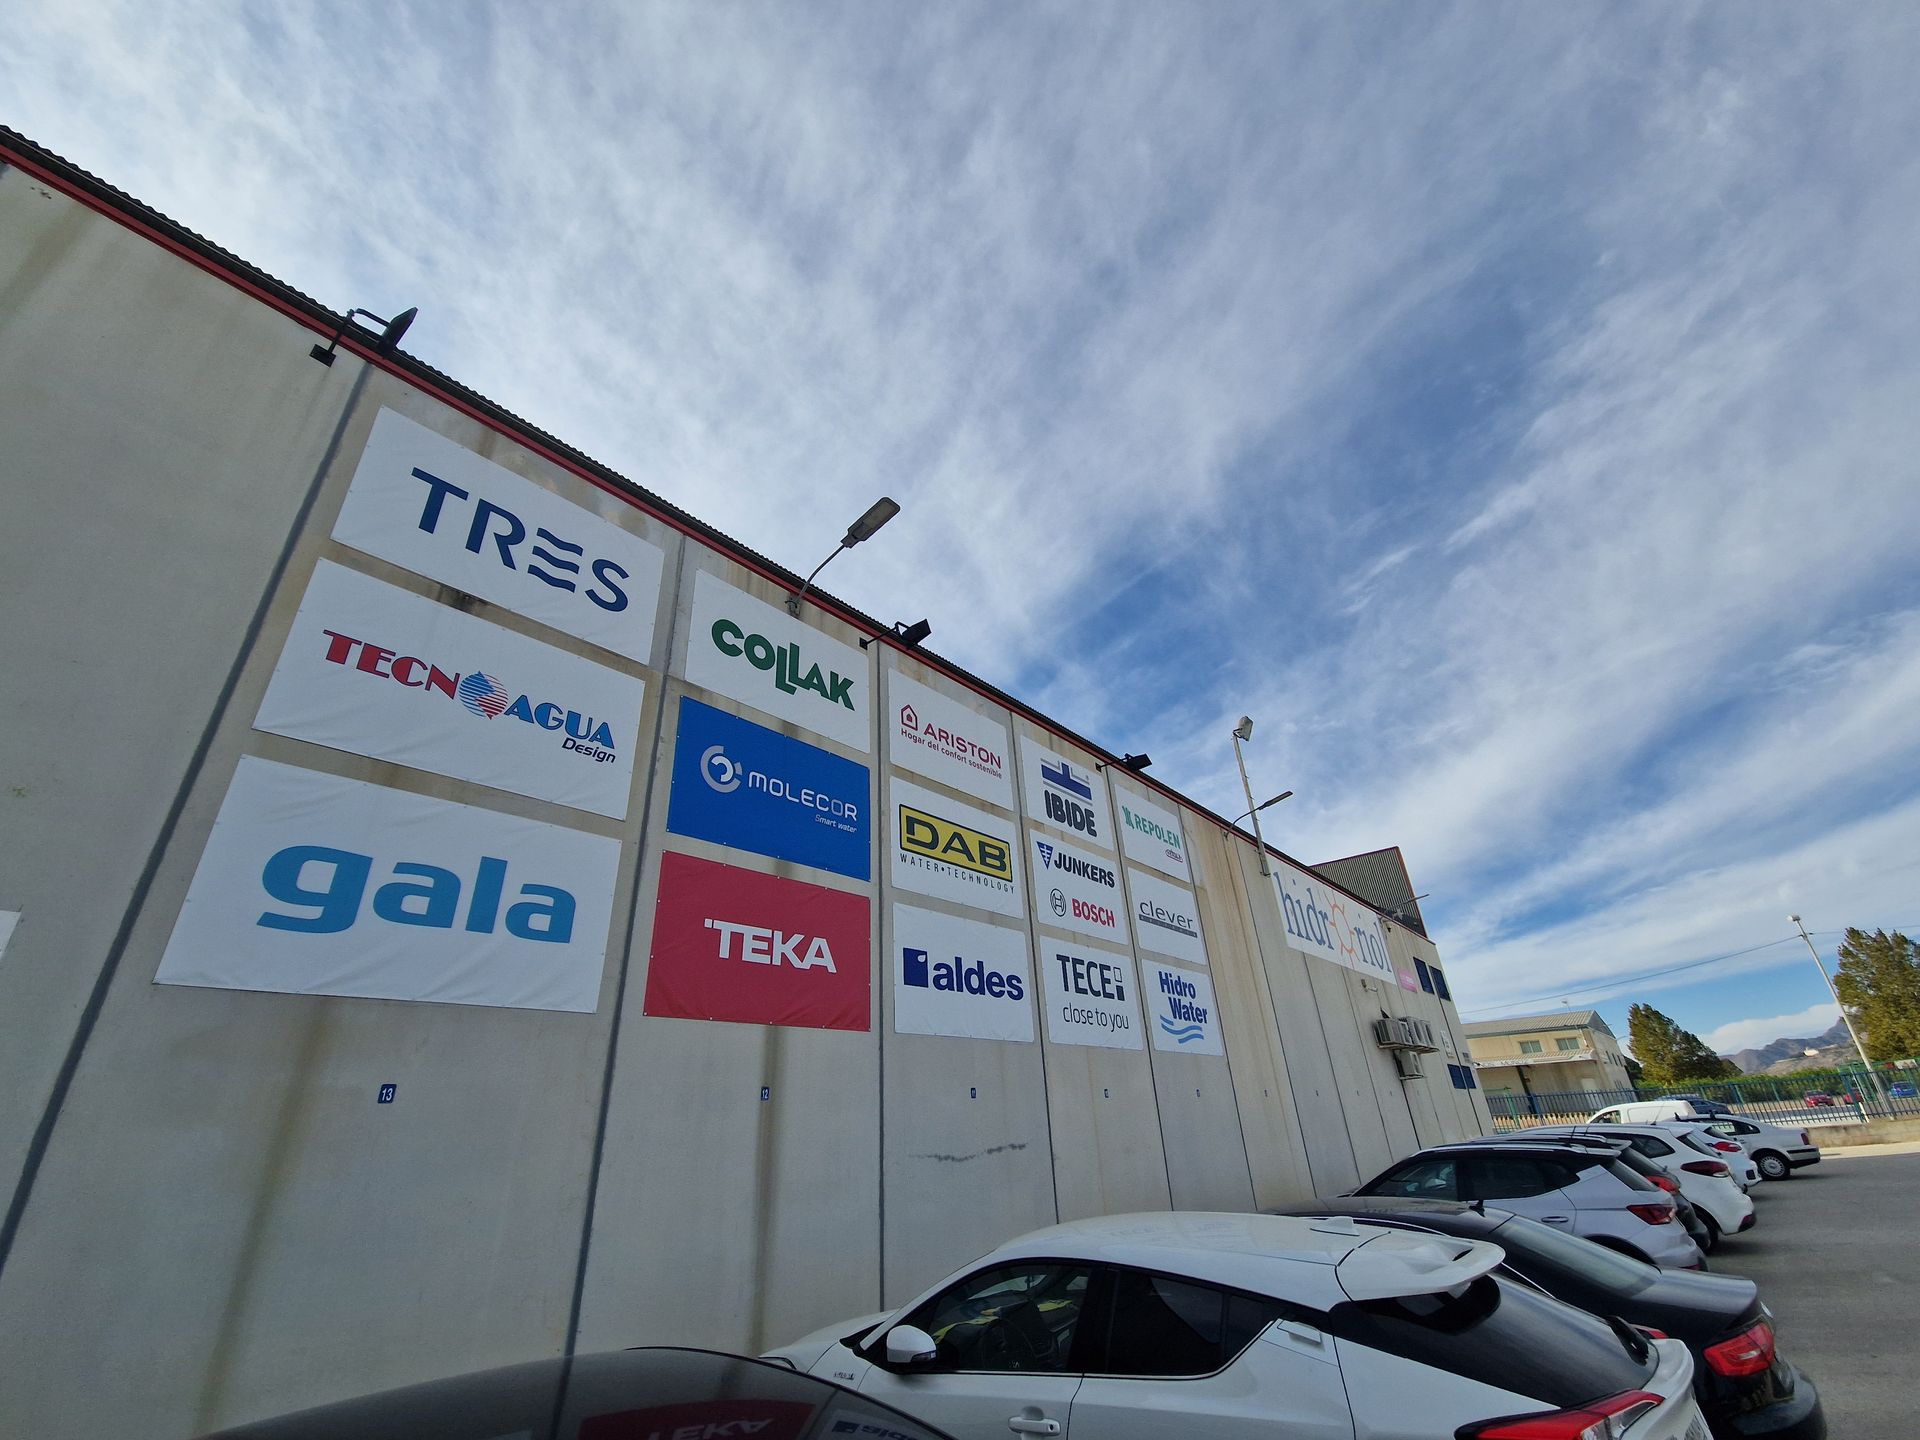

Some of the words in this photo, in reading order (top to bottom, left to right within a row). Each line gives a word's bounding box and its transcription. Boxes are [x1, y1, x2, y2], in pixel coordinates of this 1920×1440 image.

[412, 467, 630, 612] TRES
[711, 619, 856, 711] COLLAK
[562, 737, 617, 763] Design
[901, 728, 925, 743] Hogar
[927, 741, 939, 751] del
[941, 747, 967, 763] confort
[968, 759, 1002, 779] sostenible
[924, 723, 1001, 769] ARISTON
[748, 771, 857, 821] MOLECOR
[1044, 790, 1097, 837] IBIDE
[815, 814, 836, 827] Smart
[837, 821, 857, 833] water
[906, 815, 1007, 872] DAB
[1134, 813, 1181, 849] REPOLEN
[1054, 852, 1115, 888] JUNKERS
[256, 845, 576, 944] gala
[1072, 898, 1115, 928] BOSCH
[1140, 900, 1193, 929] clever
[704, 918, 837, 973] TEKA
[932, 956, 1024, 1001] aldes
[1056, 954, 1115, 1000] TECE
[1158, 971, 1196, 999] Hidro
[1063, 1002, 1093, 1026] close
[1095, 1008, 1107, 1027] to
[1110, 1014, 1129, 1032] you
[1168, 997, 1208, 1024] Water
[380, 1086, 394, 1101] 13
